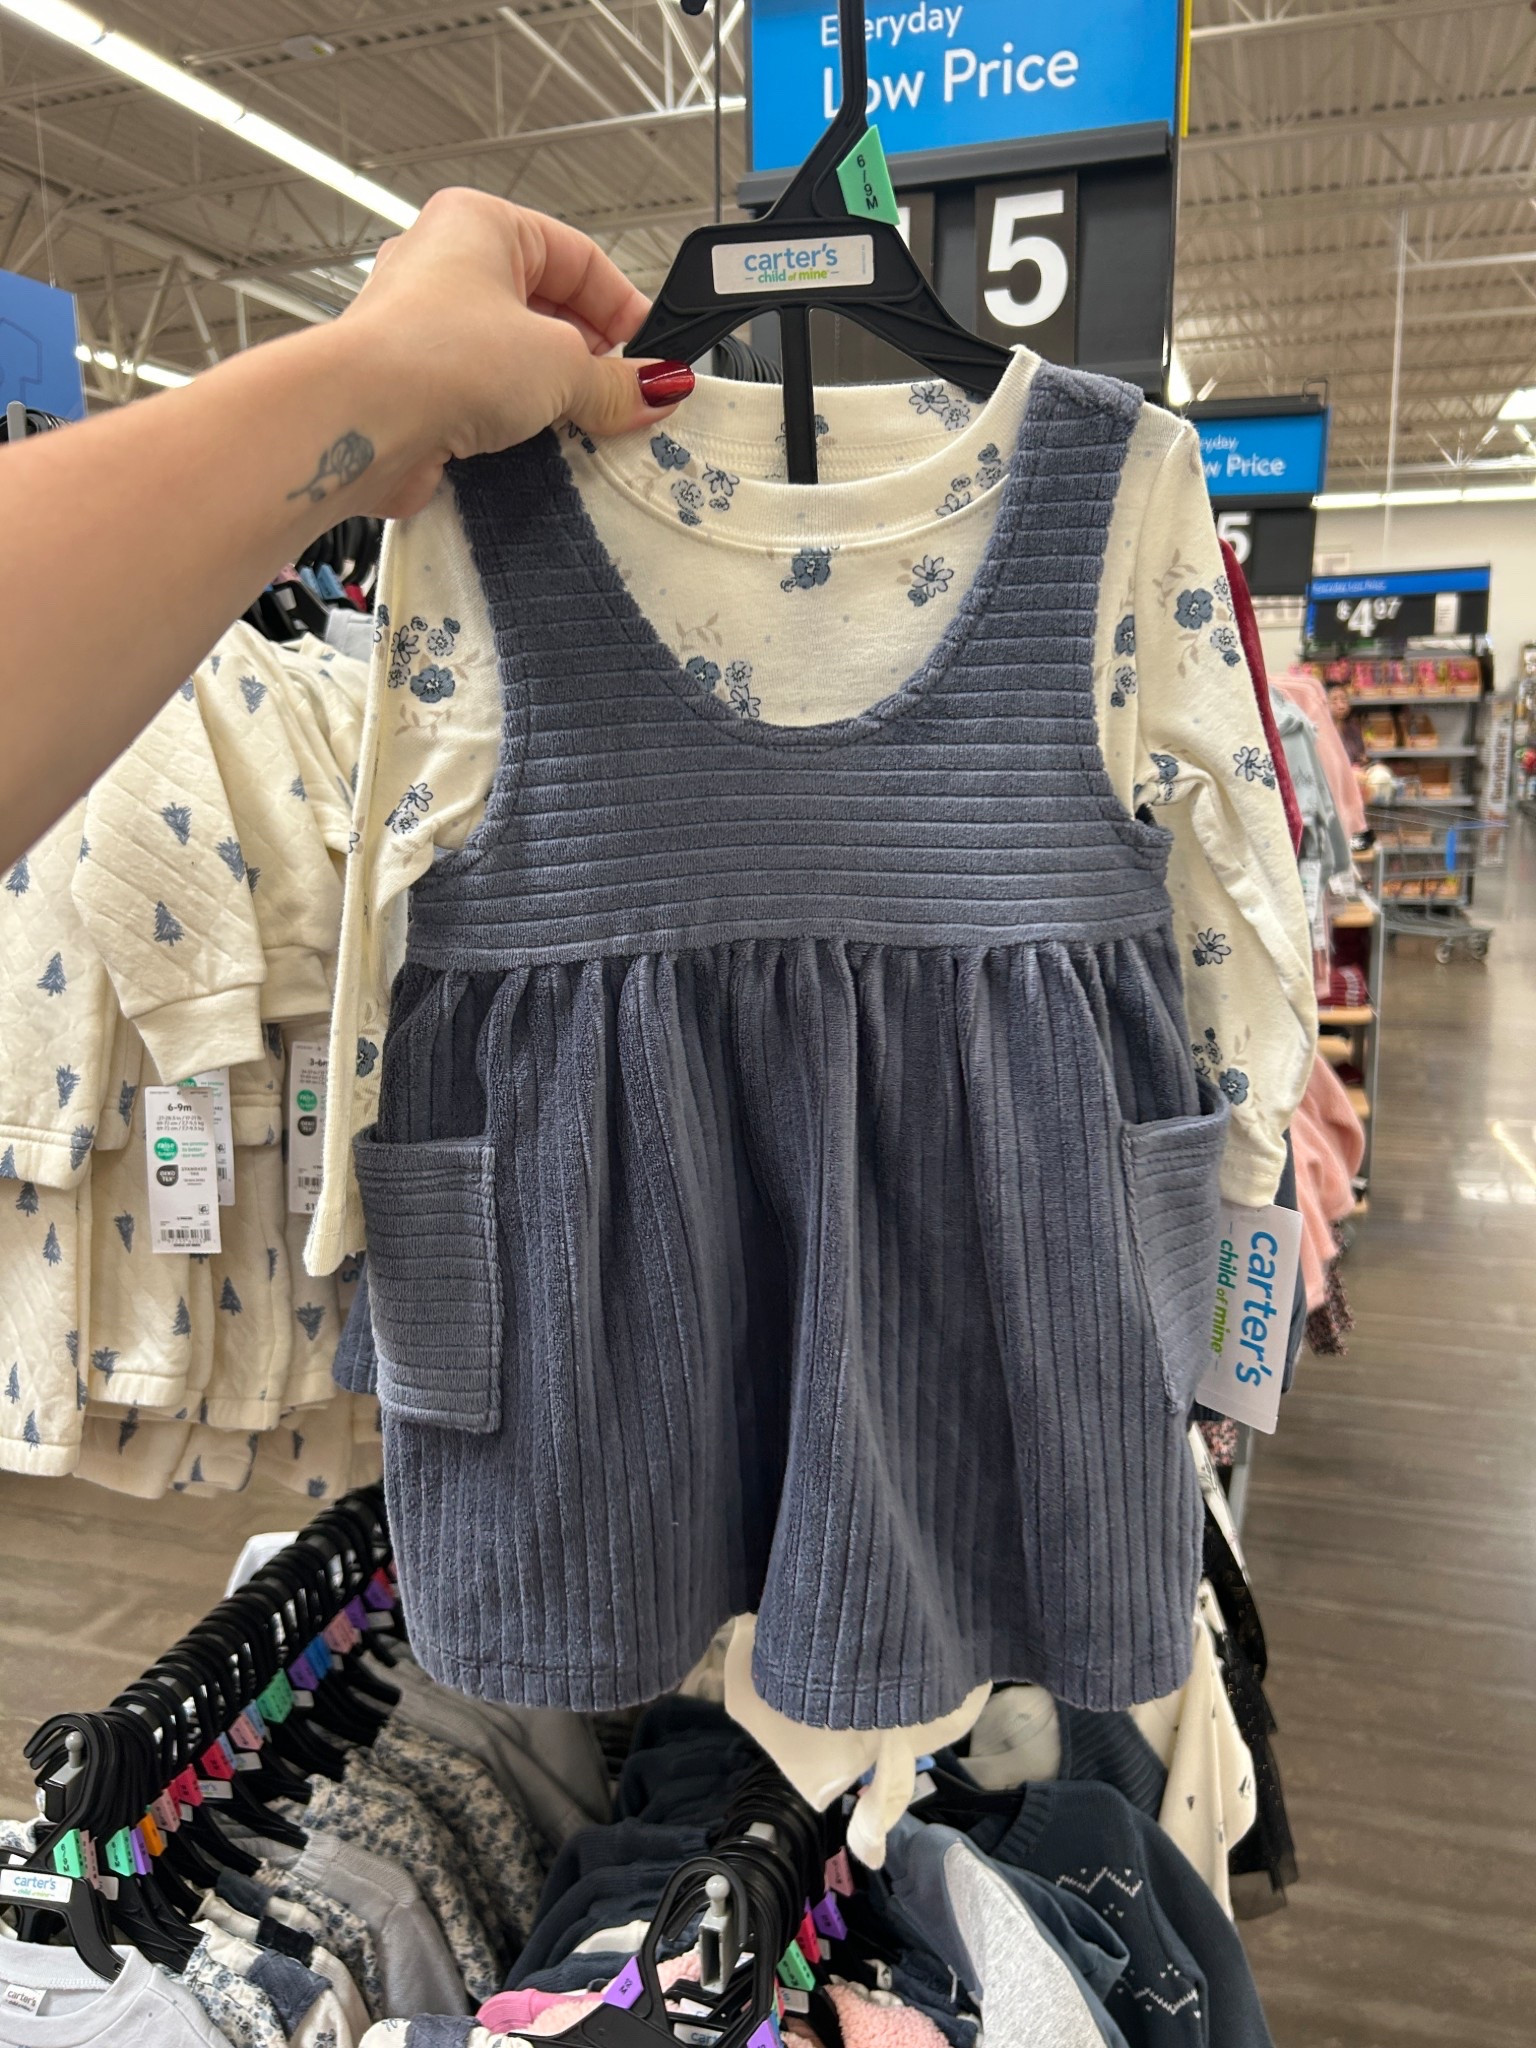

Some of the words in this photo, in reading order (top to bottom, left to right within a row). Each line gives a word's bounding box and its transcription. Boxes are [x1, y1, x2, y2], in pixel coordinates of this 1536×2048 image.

[821, 1, 963, 47] Eeryday
[944, 42, 1079, 103] Price
[744, 243, 838, 271] carter's
[758, 269, 786, 283] child
[788, 272, 797, 281] of
[798, 268, 828, 281] mine
[983, 189, 1069, 327] 5
[1227, 453, 1287, 477] Price
[1217, 511, 1252, 565] 5
[167, 1103, 192, 1112] 6-9m
[1217, 1239, 1239, 1290] child
[1216, 1288, 1229, 1306] of
[1236, 1231, 1278, 1387] carter's
[1211, 1307, 1229, 1353] mine
[14, 1876, 56, 1890] carter's
[8, 1991, 37, 2007] carter's
